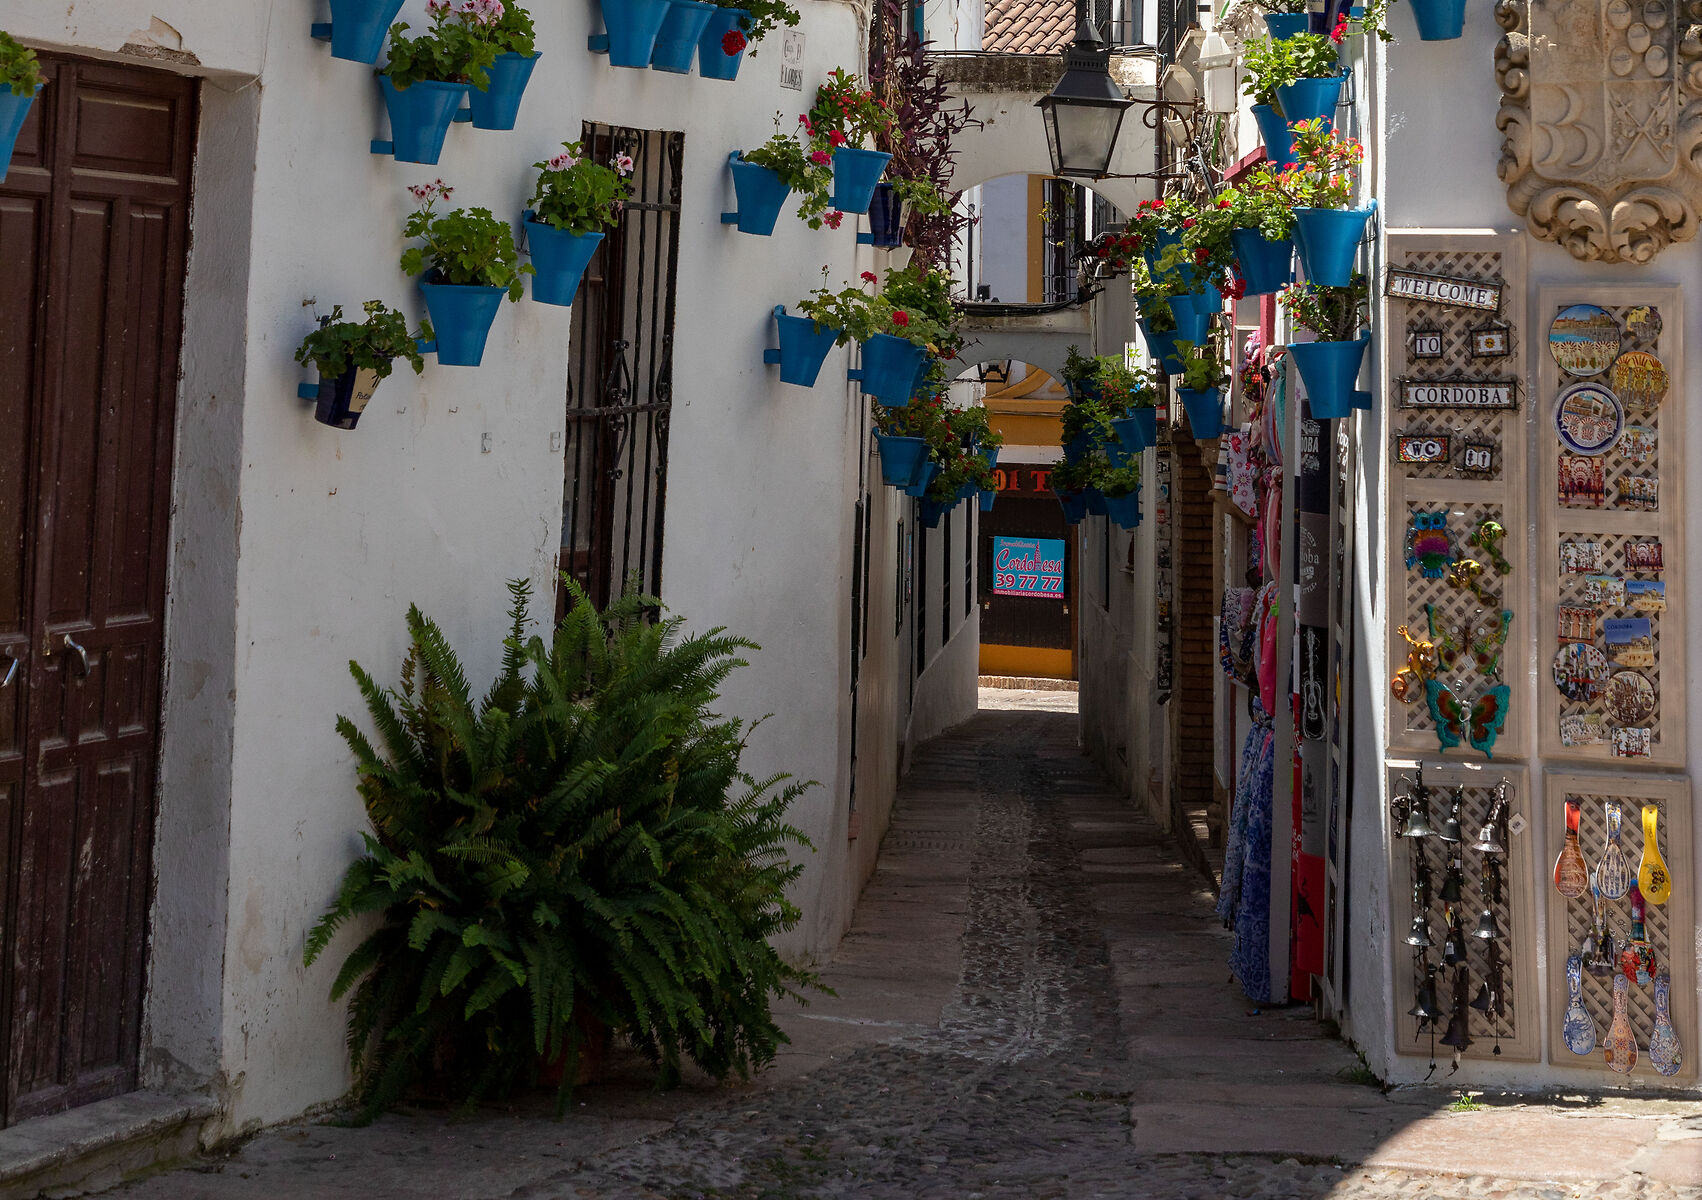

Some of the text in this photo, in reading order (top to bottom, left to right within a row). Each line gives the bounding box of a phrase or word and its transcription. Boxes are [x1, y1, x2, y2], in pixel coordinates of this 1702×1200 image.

[1399, 277, 1489, 305] WELCOME
[1416, 337, 1440, 353] TO
[1414, 387, 1503, 404] CORDOBA
[1411, 442, 1436, 456] WC
[995, 573, 1063, 591] 39 77 77
